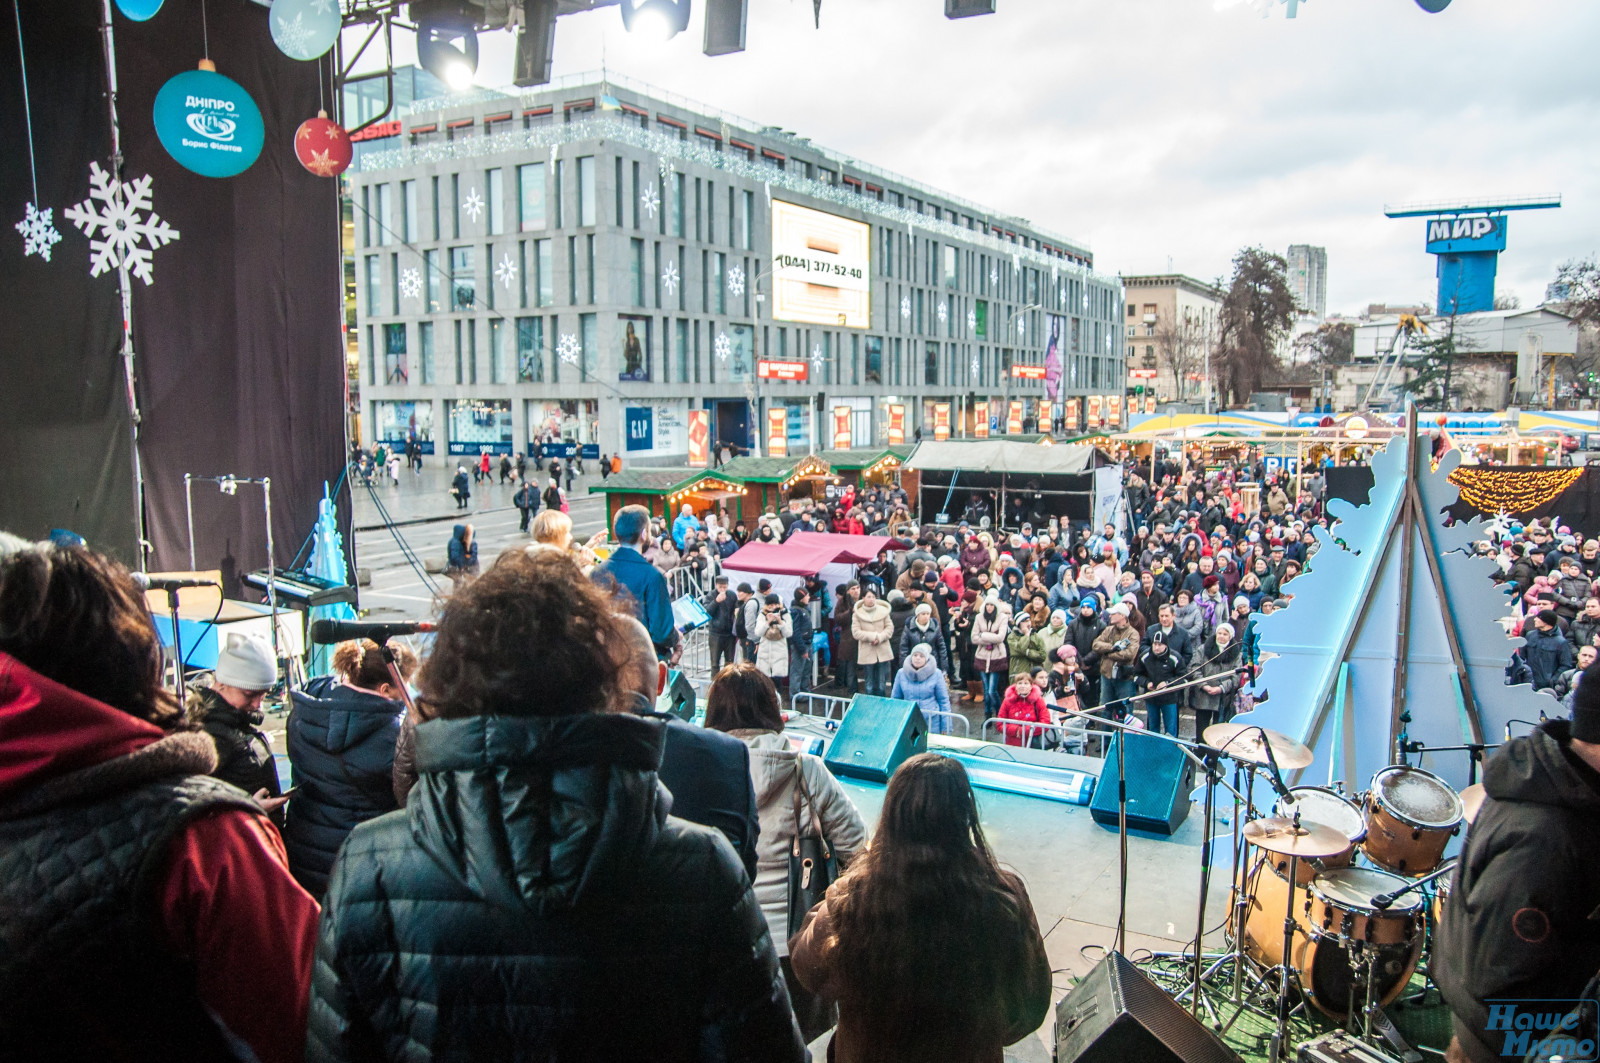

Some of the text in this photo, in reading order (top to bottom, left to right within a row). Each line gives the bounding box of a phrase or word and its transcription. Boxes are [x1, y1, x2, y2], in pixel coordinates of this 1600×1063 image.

[185, 95, 235, 112] ДНІПРО
[182, 138, 242, 153] Борис Філатов
[813, 260, 862, 279] 377-52-40
[631, 420, 648, 439] GAP
